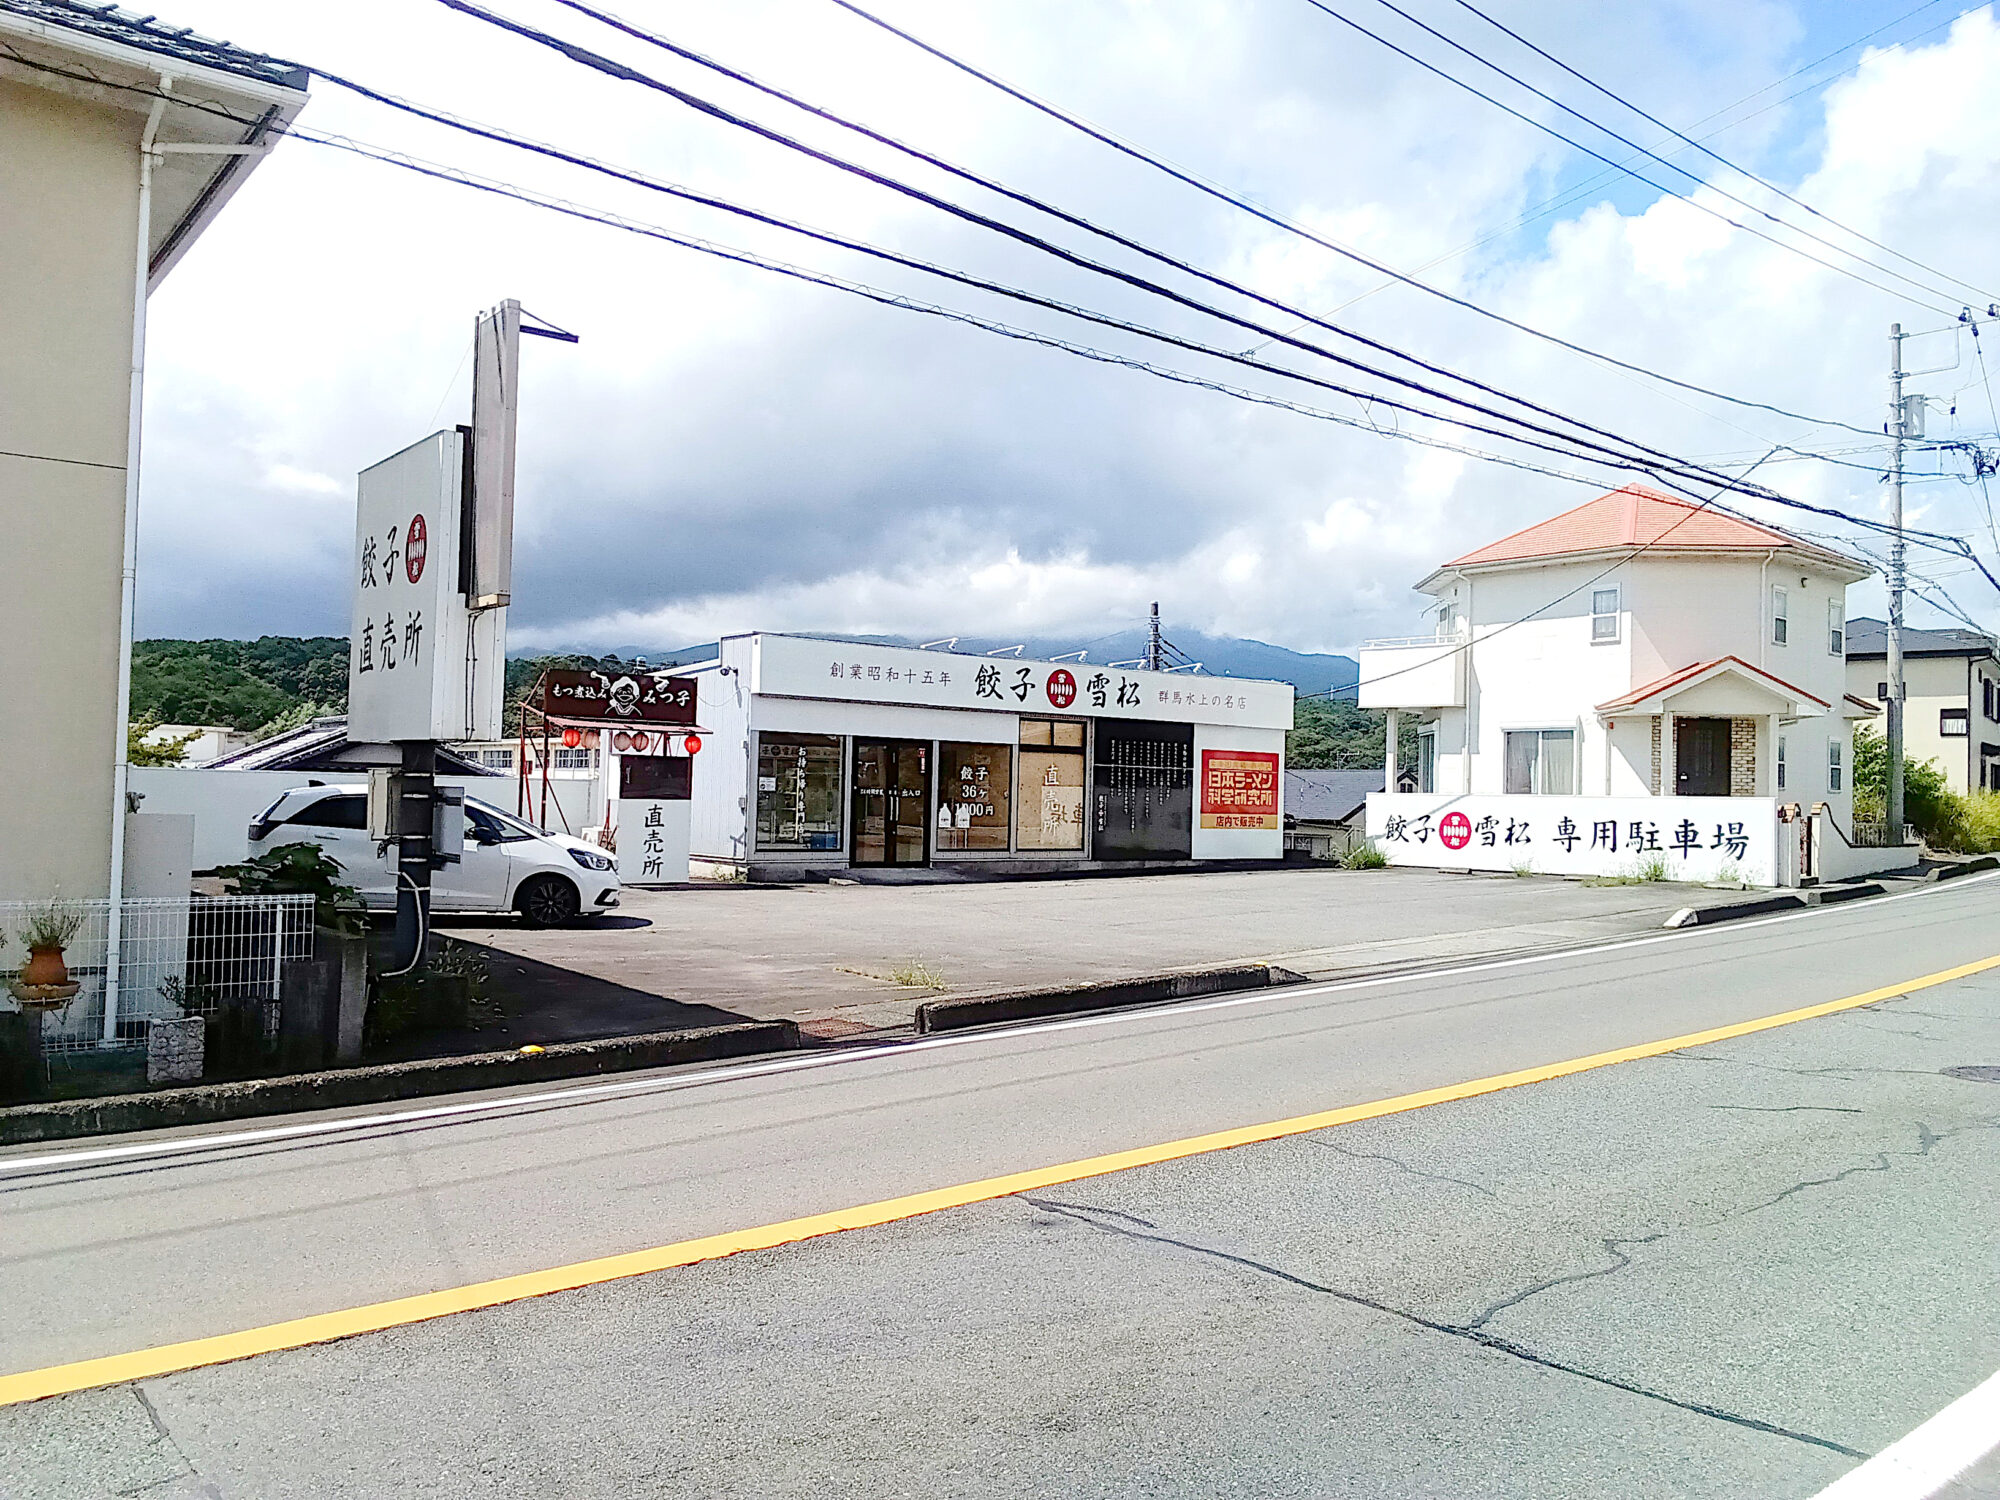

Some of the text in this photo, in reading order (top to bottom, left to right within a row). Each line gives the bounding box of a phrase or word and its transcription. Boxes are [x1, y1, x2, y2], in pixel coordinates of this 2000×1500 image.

[361, 525, 400, 589] 餃子
[359, 610, 423, 675] 直売所
[829, 661, 951, 687] 創業昭和十五年
[974, 664, 1141, 708] 餃子 雪松
[552, 683, 691, 706] もつ煮込み みつ子
[1158, 689, 1248, 710] 群馬水上の名店
[961, 766, 989, 780] 餃子
[1208, 770, 1273, 789] 日本ラーメン
[1043, 764, 1060, 836] 直売所
[1207, 788, 1273, 806] 科学研究所
[1215, 815, 1264, 828] 店内で販売中
[642, 804, 665, 879] 直売所
[1384, 814, 1750, 862] 餃子 雪松 専用駐車場
